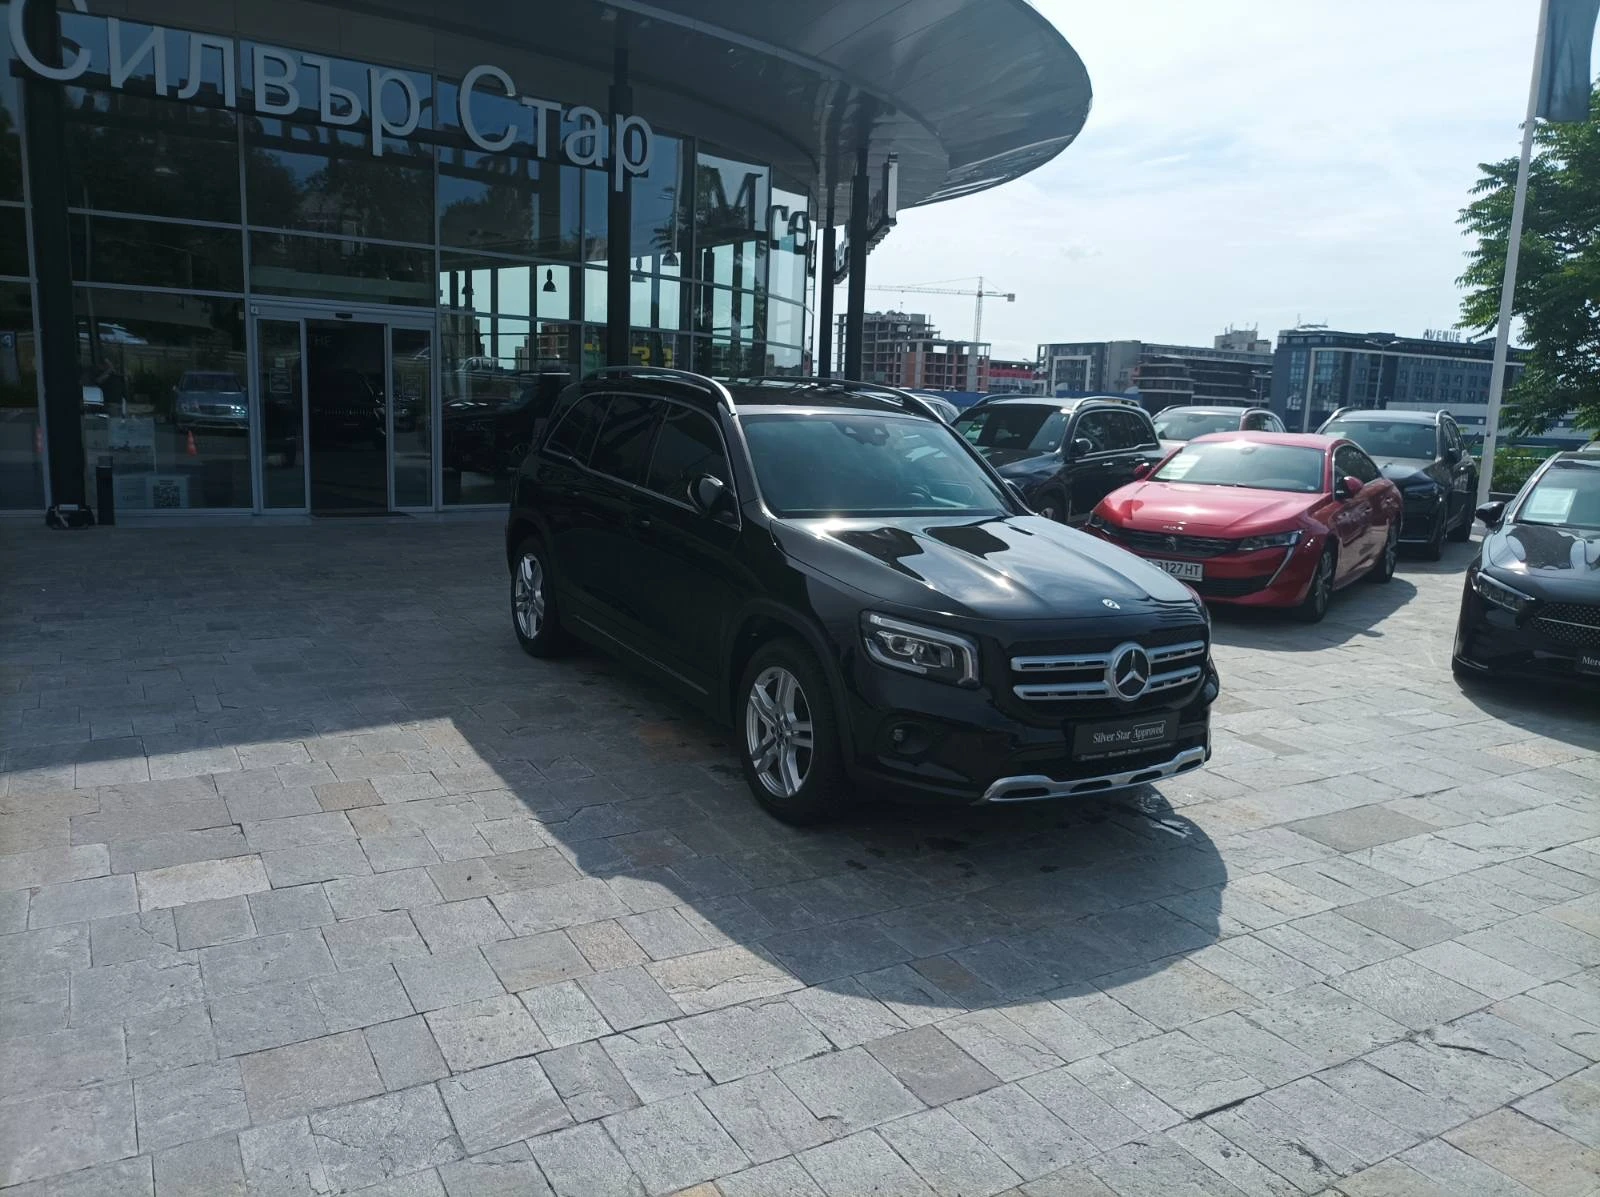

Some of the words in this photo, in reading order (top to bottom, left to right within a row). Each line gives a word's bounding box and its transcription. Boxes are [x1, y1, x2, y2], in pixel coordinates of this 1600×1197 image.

[8, 0, 421, 157] Силвър
[458, 64, 655, 192] Стар
[1423, 329, 1461, 342] AVENUE
[1185, 563, 1201, 576] HT
[1093, 731, 1115, 743] Silver
[1116, 729, 1131, 741] Star
[1134, 724, 1164, 739] Approved
